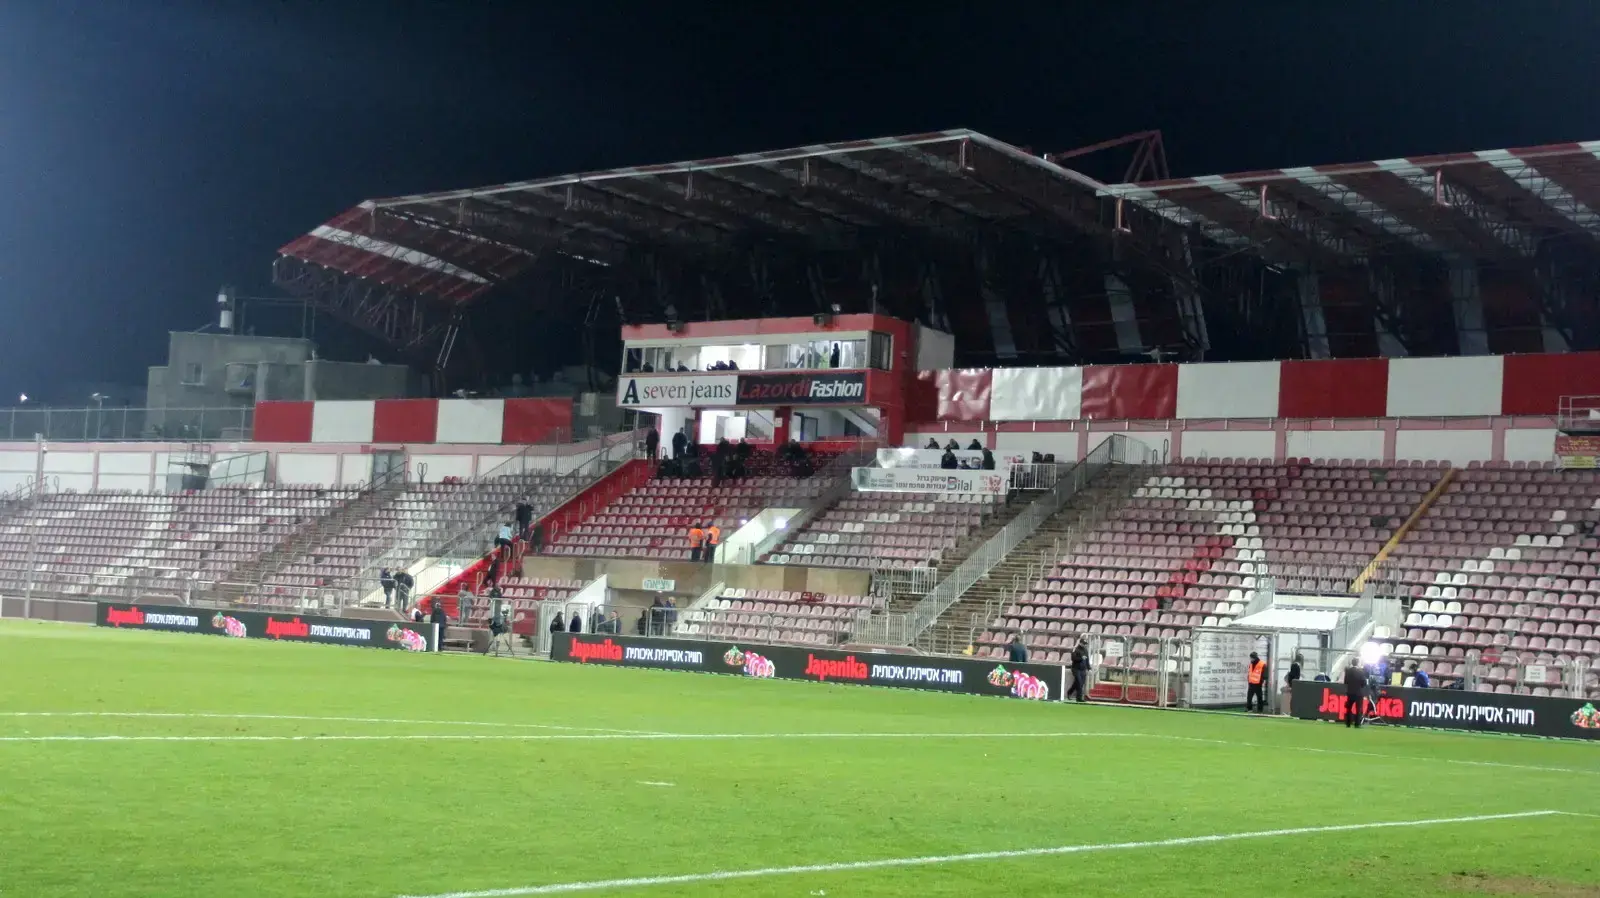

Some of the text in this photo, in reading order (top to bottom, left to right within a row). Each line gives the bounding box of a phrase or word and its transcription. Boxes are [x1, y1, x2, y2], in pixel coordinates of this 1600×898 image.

[622, 379, 732, 404] A seven jeans
[739, 379, 863, 399] Lazordi Fashion
[947, 476, 973, 491] Bilal
[569, 638, 624, 663] Japanika
[626, 647, 702, 663] חוויה אסייתית איכותית
[805, 654, 870, 681] Japanika
[871, 665, 962, 683] חוויה אסייתית איכותית
[1409, 702, 1534, 725] חוויה אסייתית איכותית
